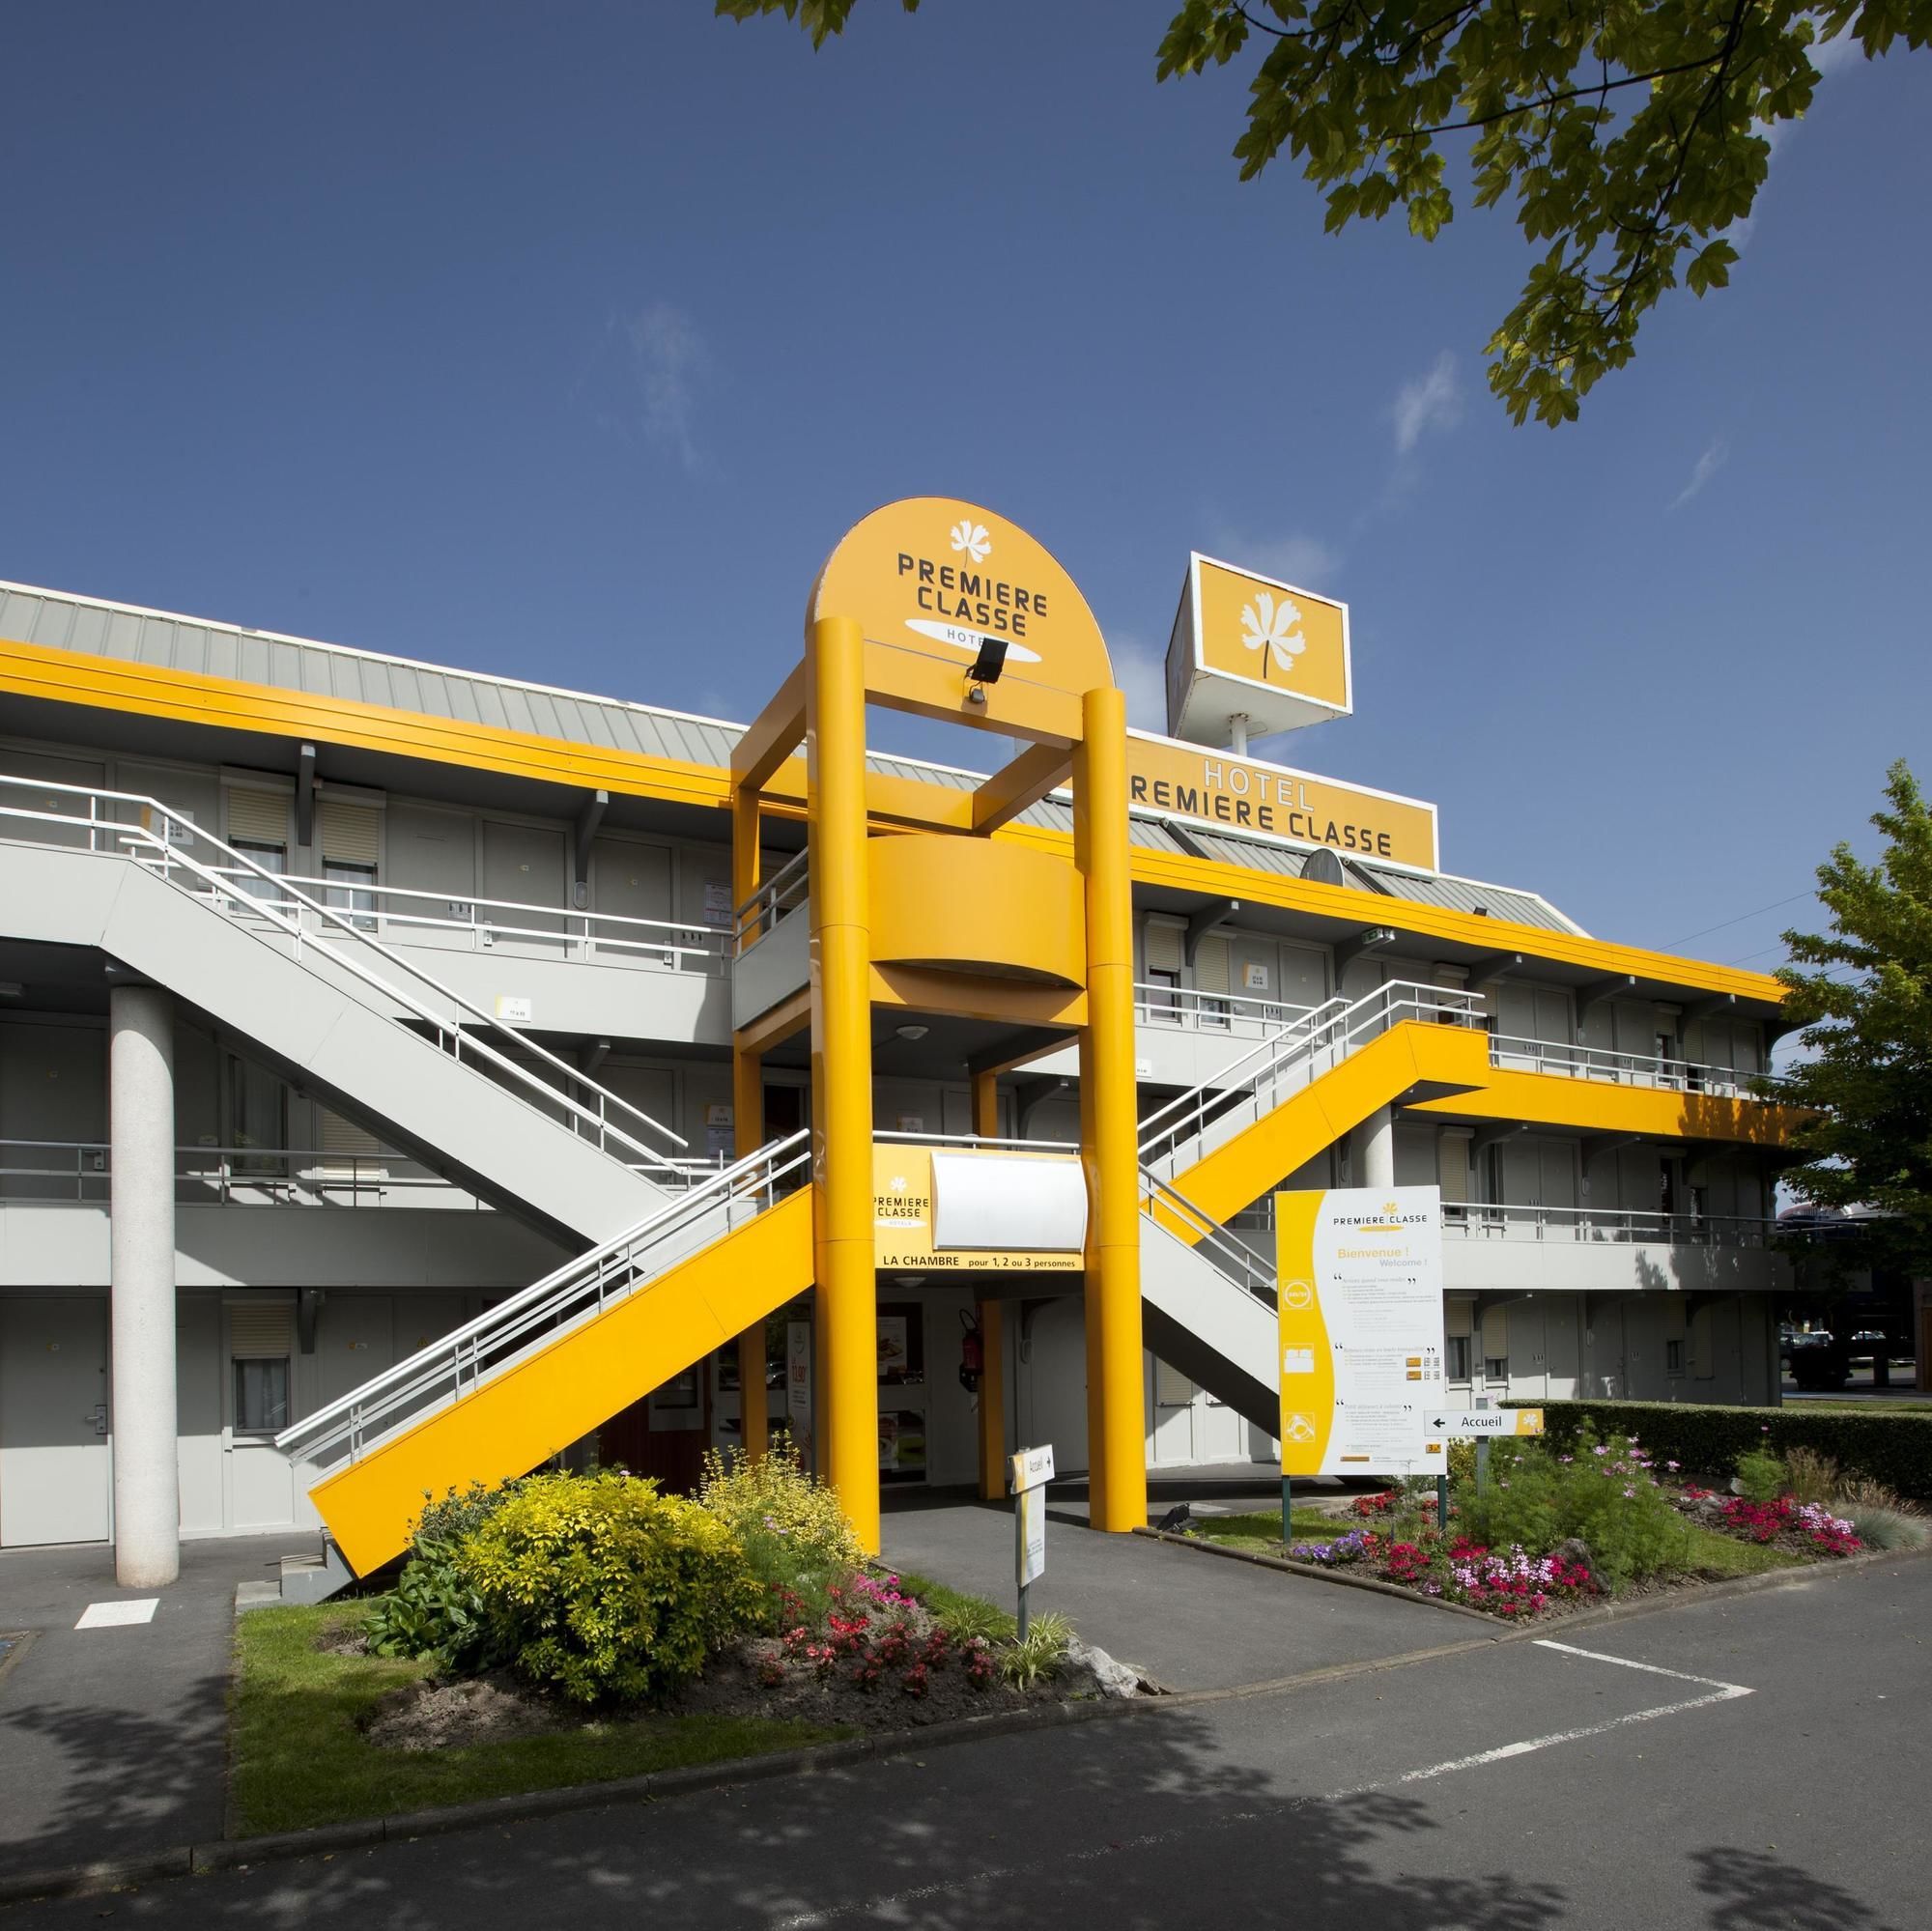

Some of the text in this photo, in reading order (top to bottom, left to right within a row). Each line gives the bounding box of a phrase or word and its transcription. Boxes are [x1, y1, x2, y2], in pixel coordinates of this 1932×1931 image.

[898, 553, 1047, 617] PREMIERE
[918, 586, 1026, 637] CLASSE
[1204, 759, 1315, 812] HOTEL
[1130, 775, 1391, 857] REMIERE CLASSE
[877, 1207, 921, 1217] CLASSE
[1333, 1216, 1384, 1225] PREMIERE
[1337, 1248, 1402, 1259] Bienvenue
[883, 1256, 899, 1265] LA
[902, 1256, 959, 1266] CHAMBRE
[992, 1258, 1000, 1267] 1,
[1003, 1258, 1009, 1267] 2
[1025, 1258, 1031, 1267] 3
[1379, 1259, 1422, 1267] Welcome
[1461, 1416, 1502, 1427] Accueil
